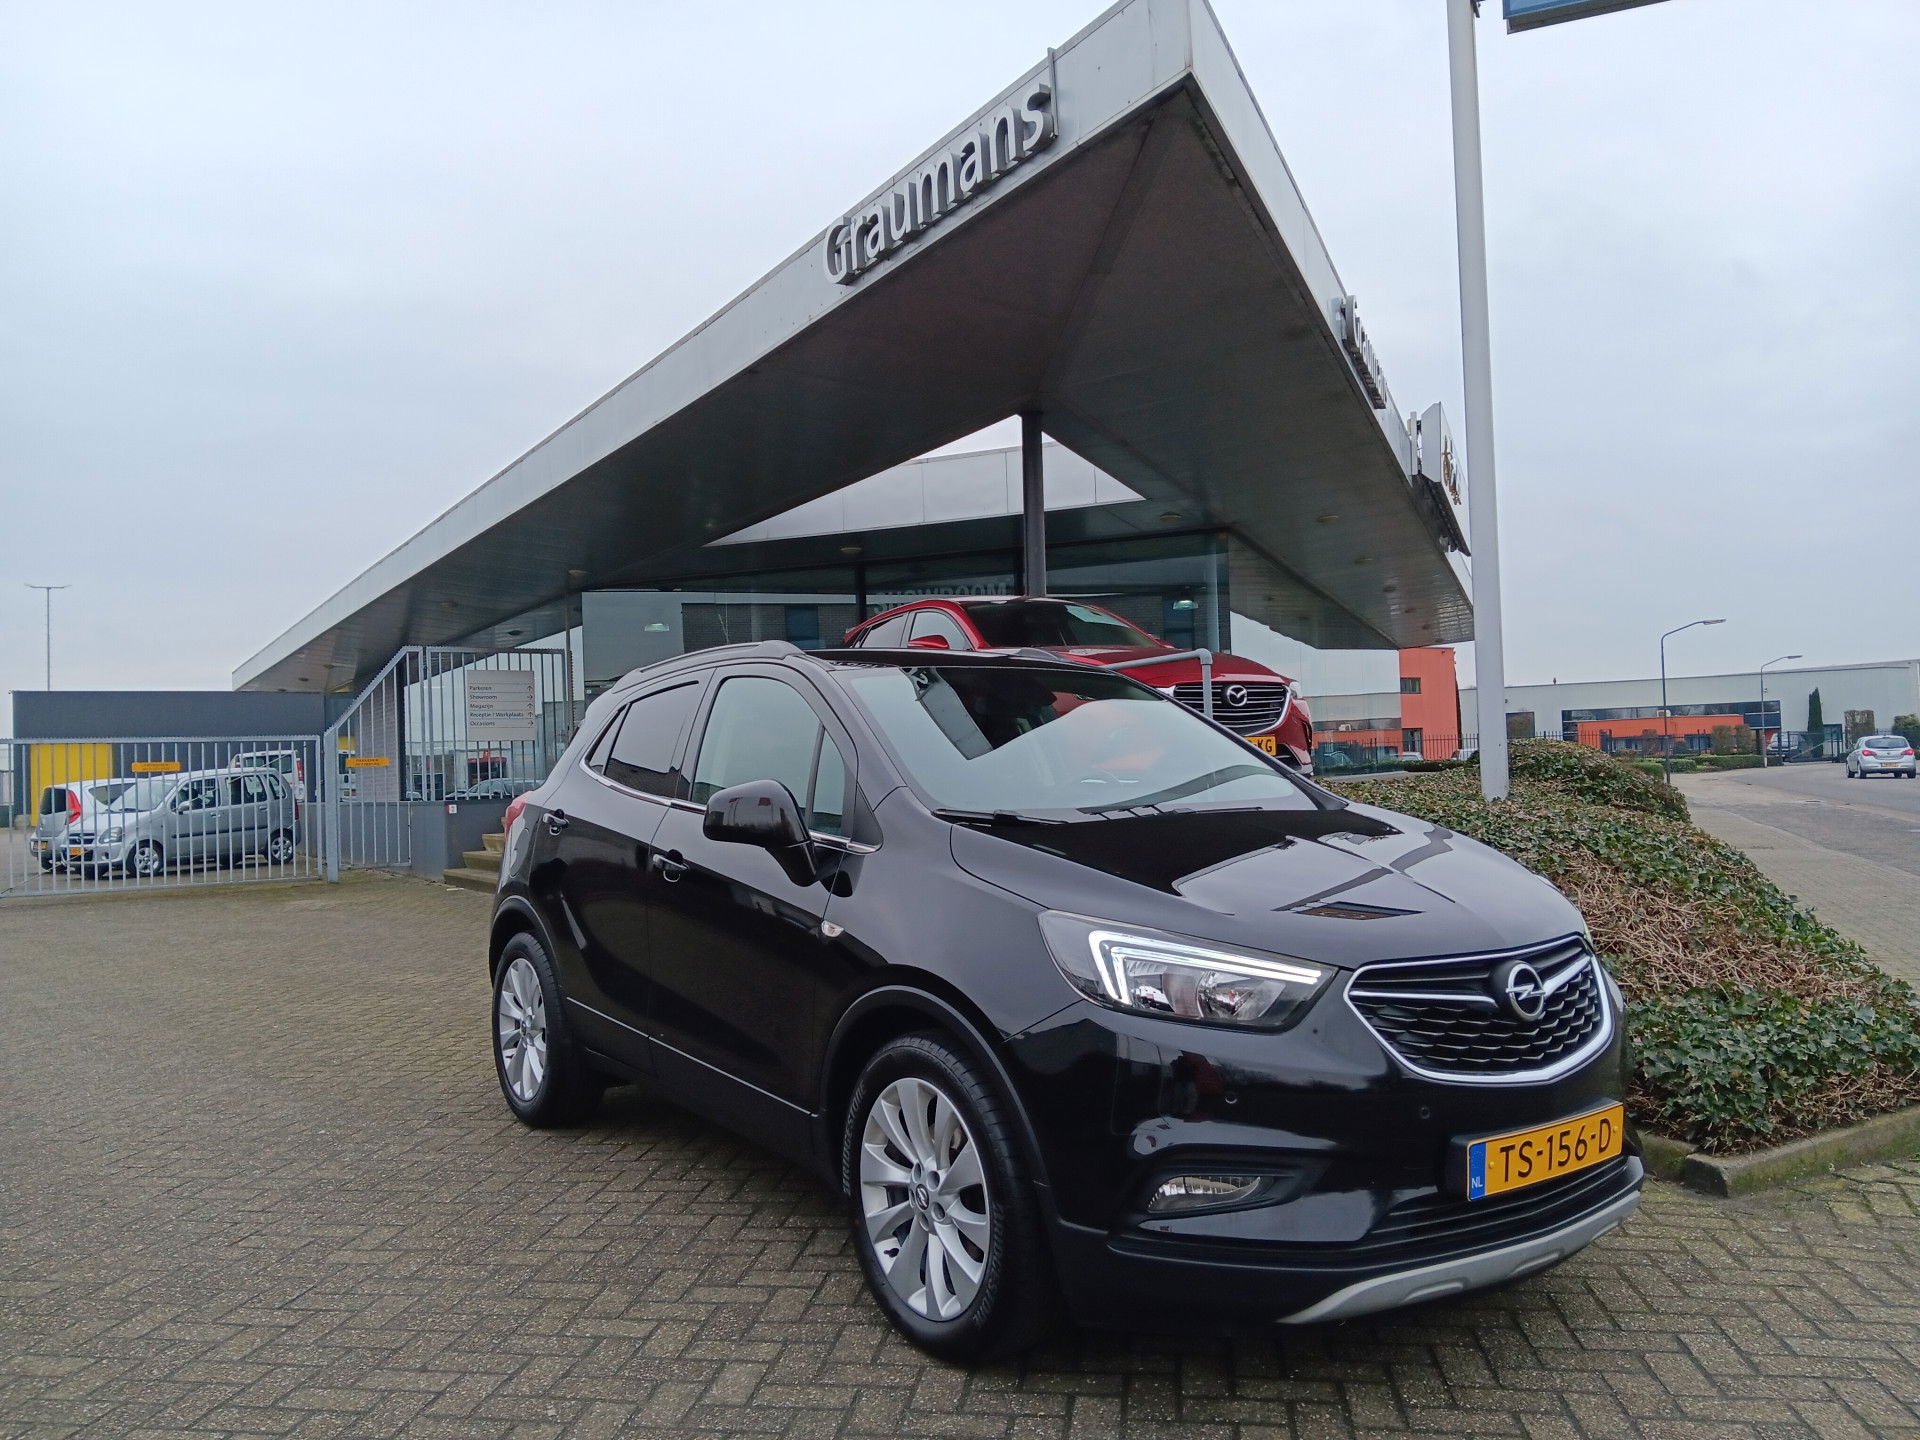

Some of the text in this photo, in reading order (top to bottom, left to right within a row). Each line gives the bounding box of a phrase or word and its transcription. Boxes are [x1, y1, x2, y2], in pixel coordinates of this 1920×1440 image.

[823, 83, 1054, 285] Graumans
[496, 711, 524, 719] Werkplaats
[1471, 1118, 1611, 1188] NL TS-156-D
